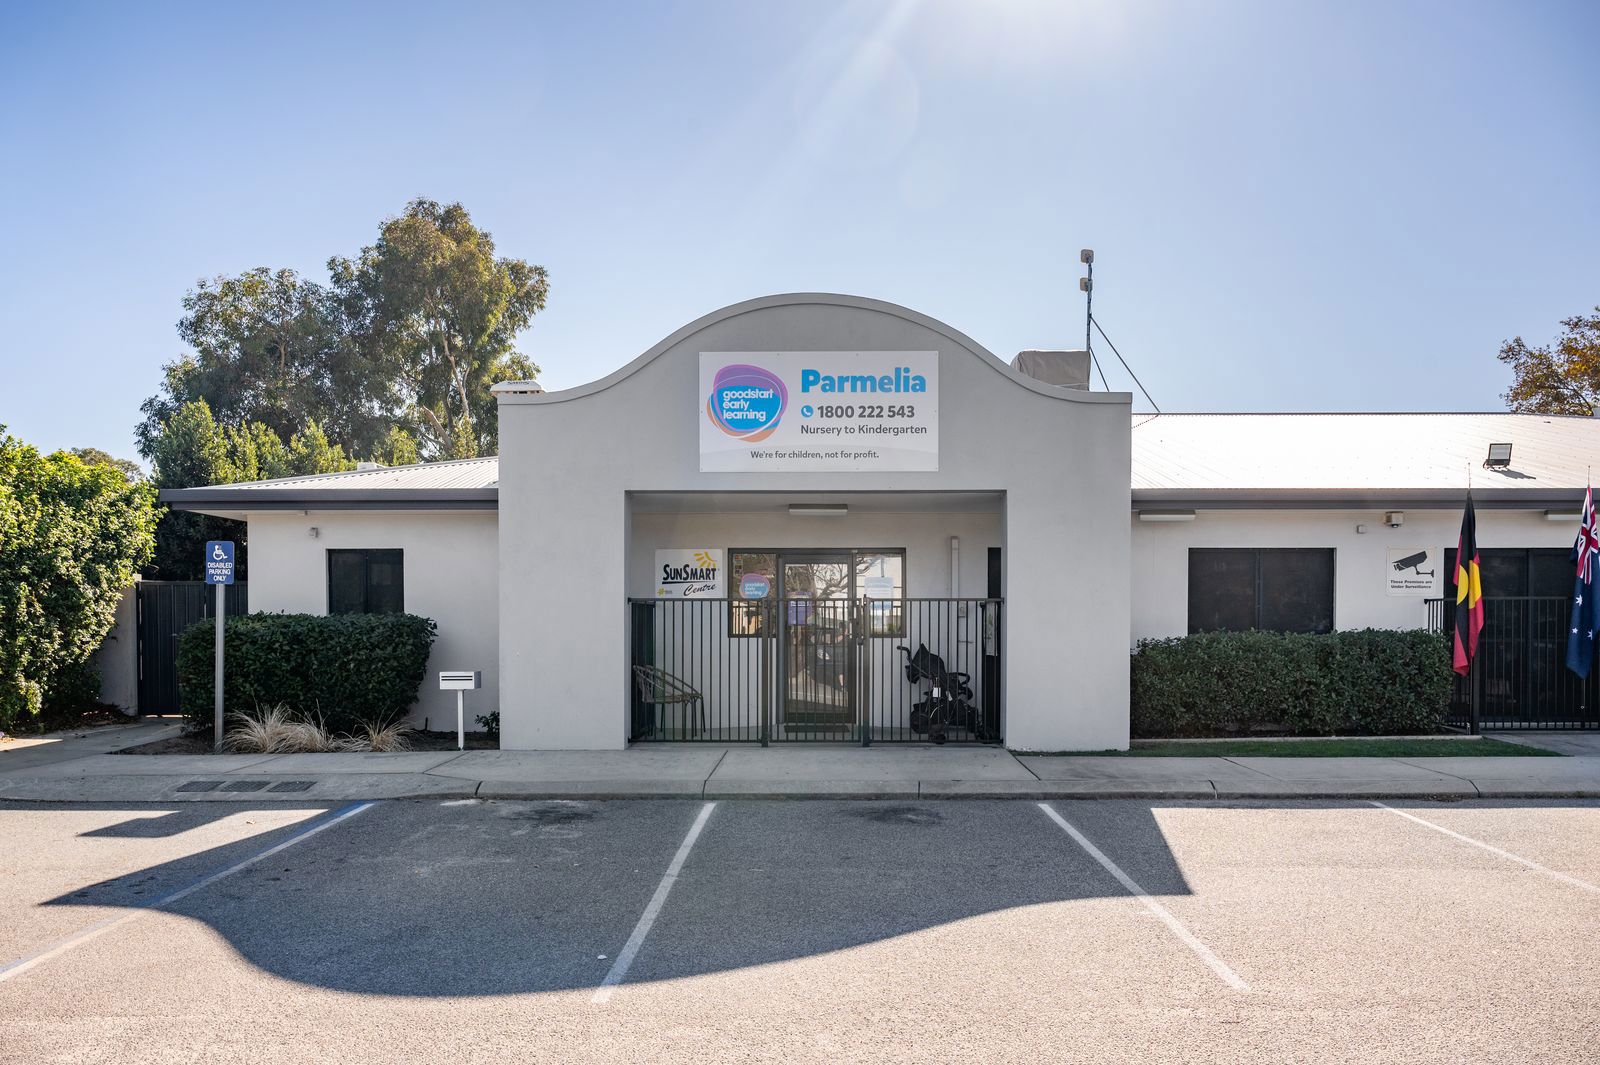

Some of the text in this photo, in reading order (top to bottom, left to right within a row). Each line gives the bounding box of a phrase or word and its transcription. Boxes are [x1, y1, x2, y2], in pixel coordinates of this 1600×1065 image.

[801, 366, 926, 393] Parmelia
[723, 389, 774, 400] goodstart
[723, 399, 749, 411] early
[723, 409, 766, 421] learning
[817, 405, 915, 418] 1800 222 543
[800, 424, 927, 436] Nursery to Kindergarten
[750, 450, 880, 461] We're for children, not for profit.
[683, 583, 717, 596] Centre
